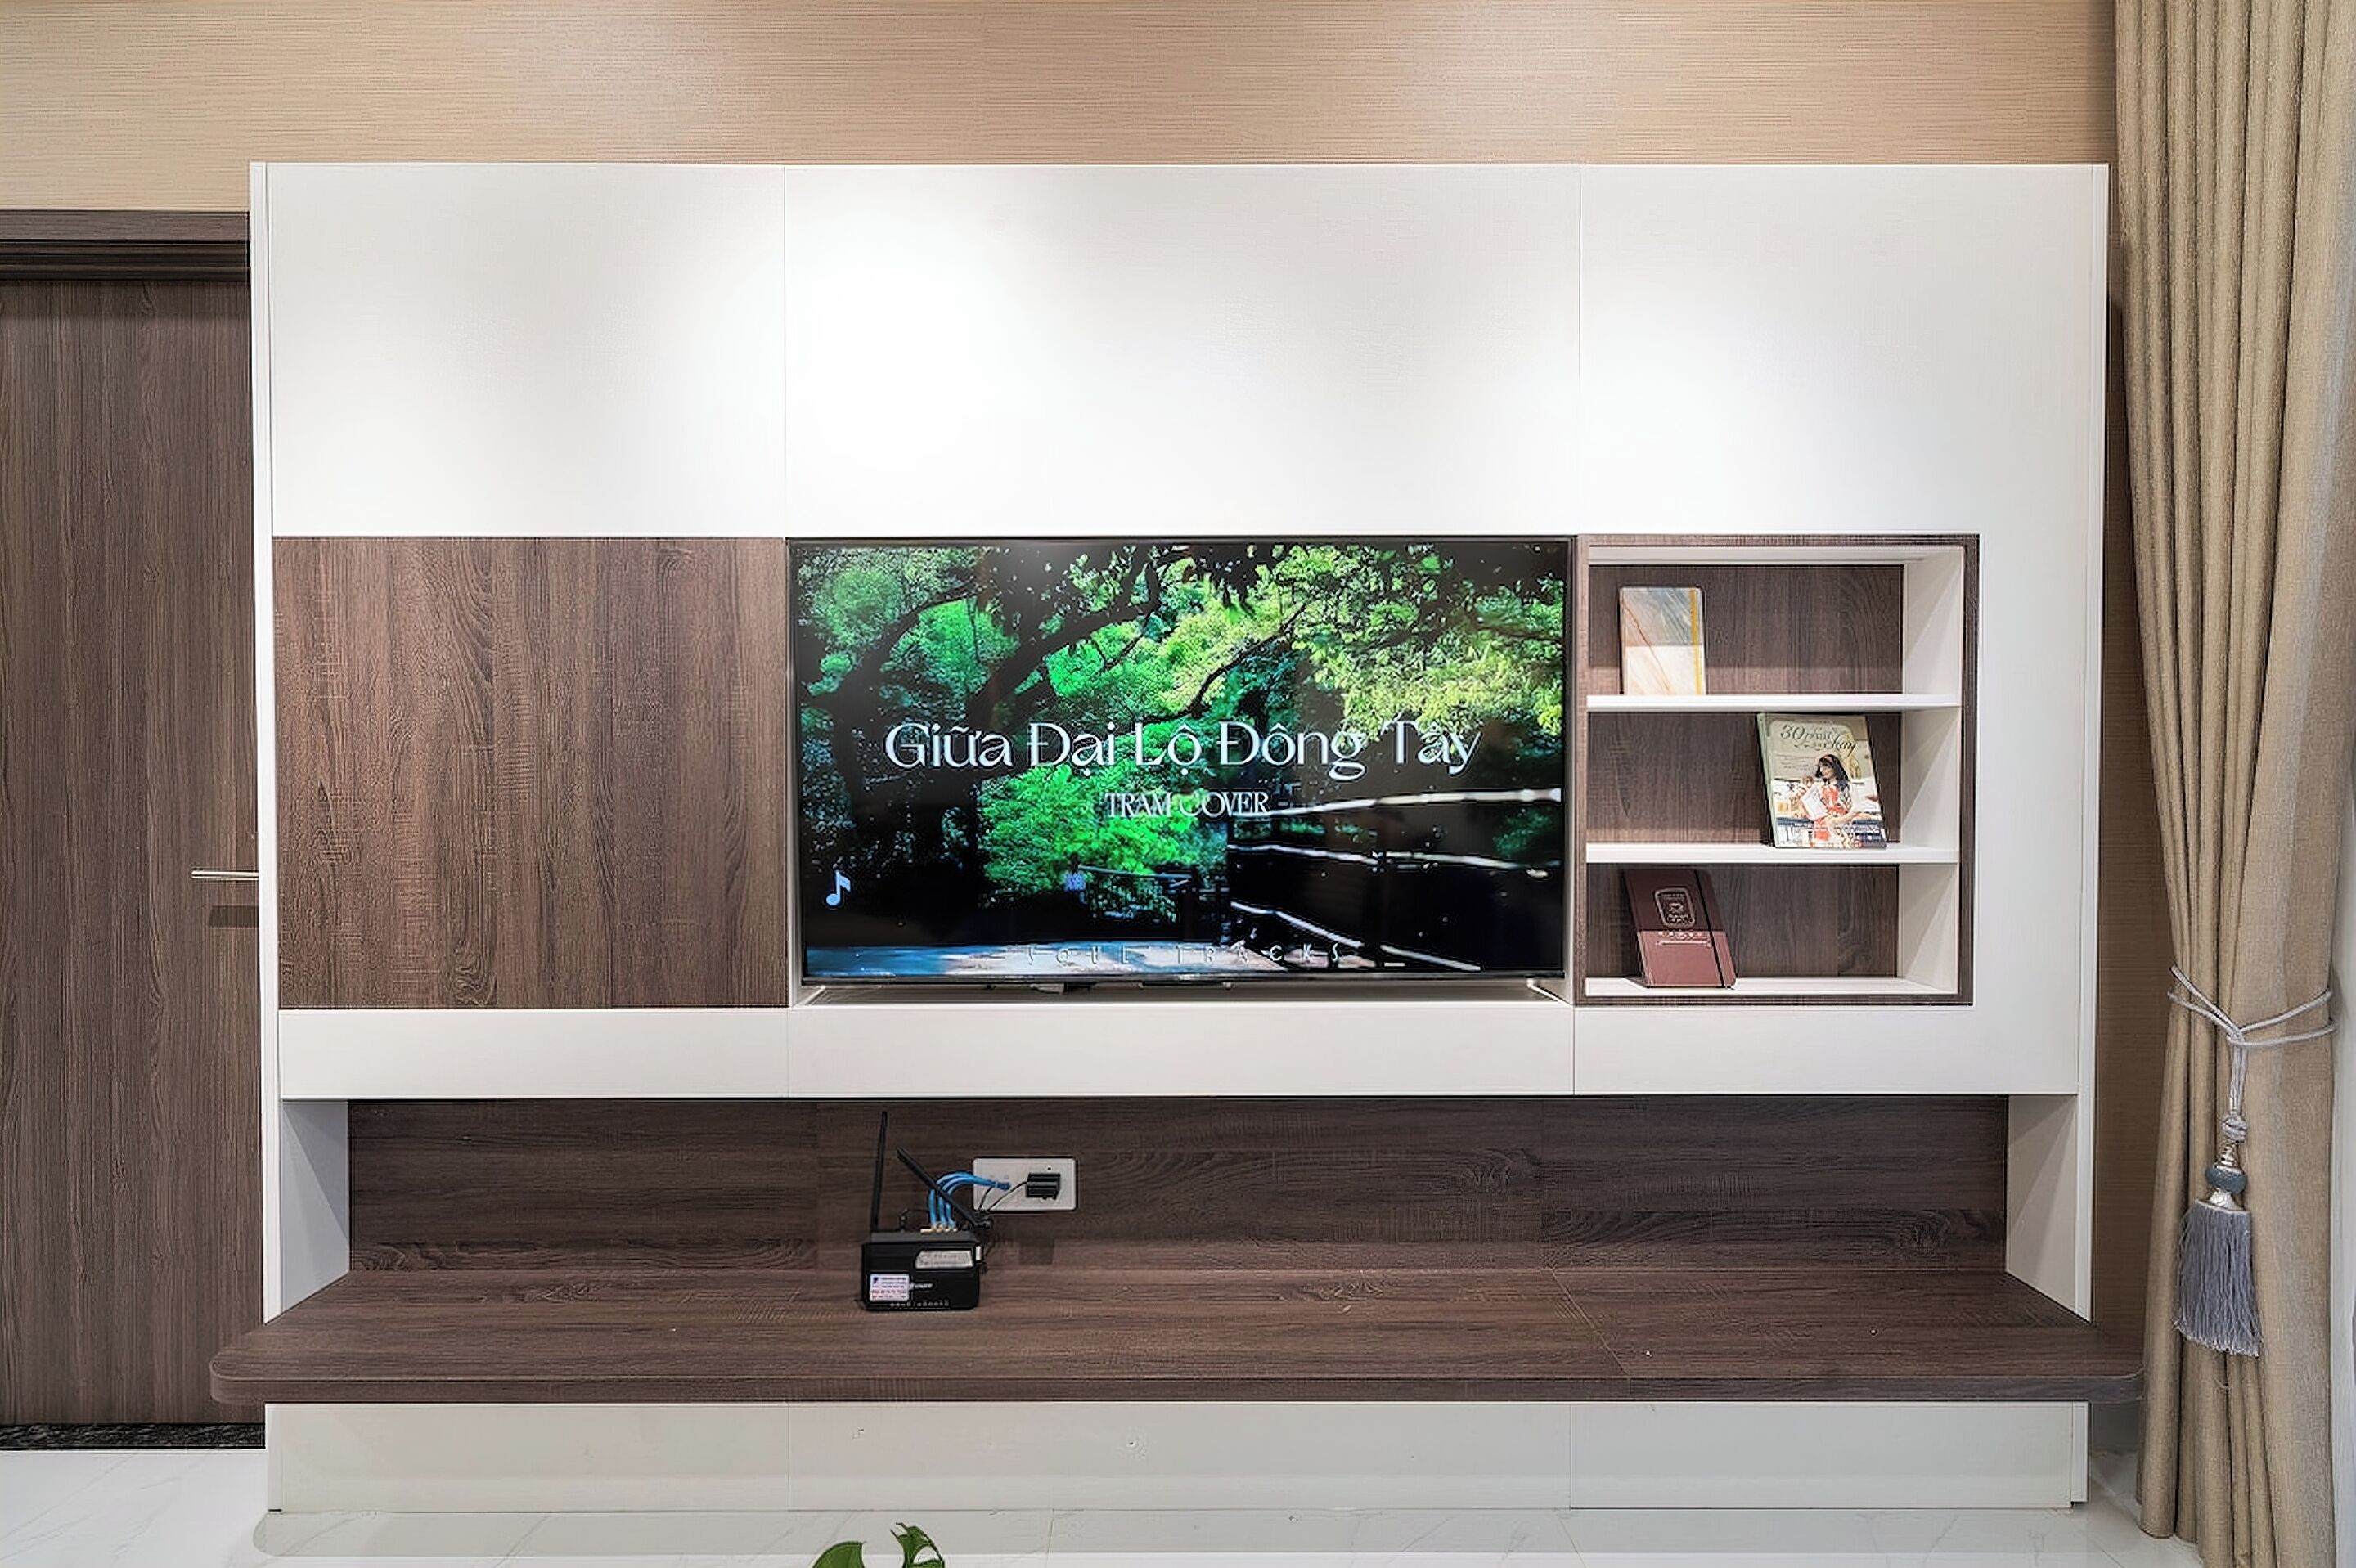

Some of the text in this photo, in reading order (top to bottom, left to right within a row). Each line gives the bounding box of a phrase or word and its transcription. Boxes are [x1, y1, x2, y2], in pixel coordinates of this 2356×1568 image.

[1780, 724, 1805, 740] 30
[884, 720, 1481, 781] Giữa Đại Lộ Đông Tây
[1178, 791, 1270, 818] COVER
